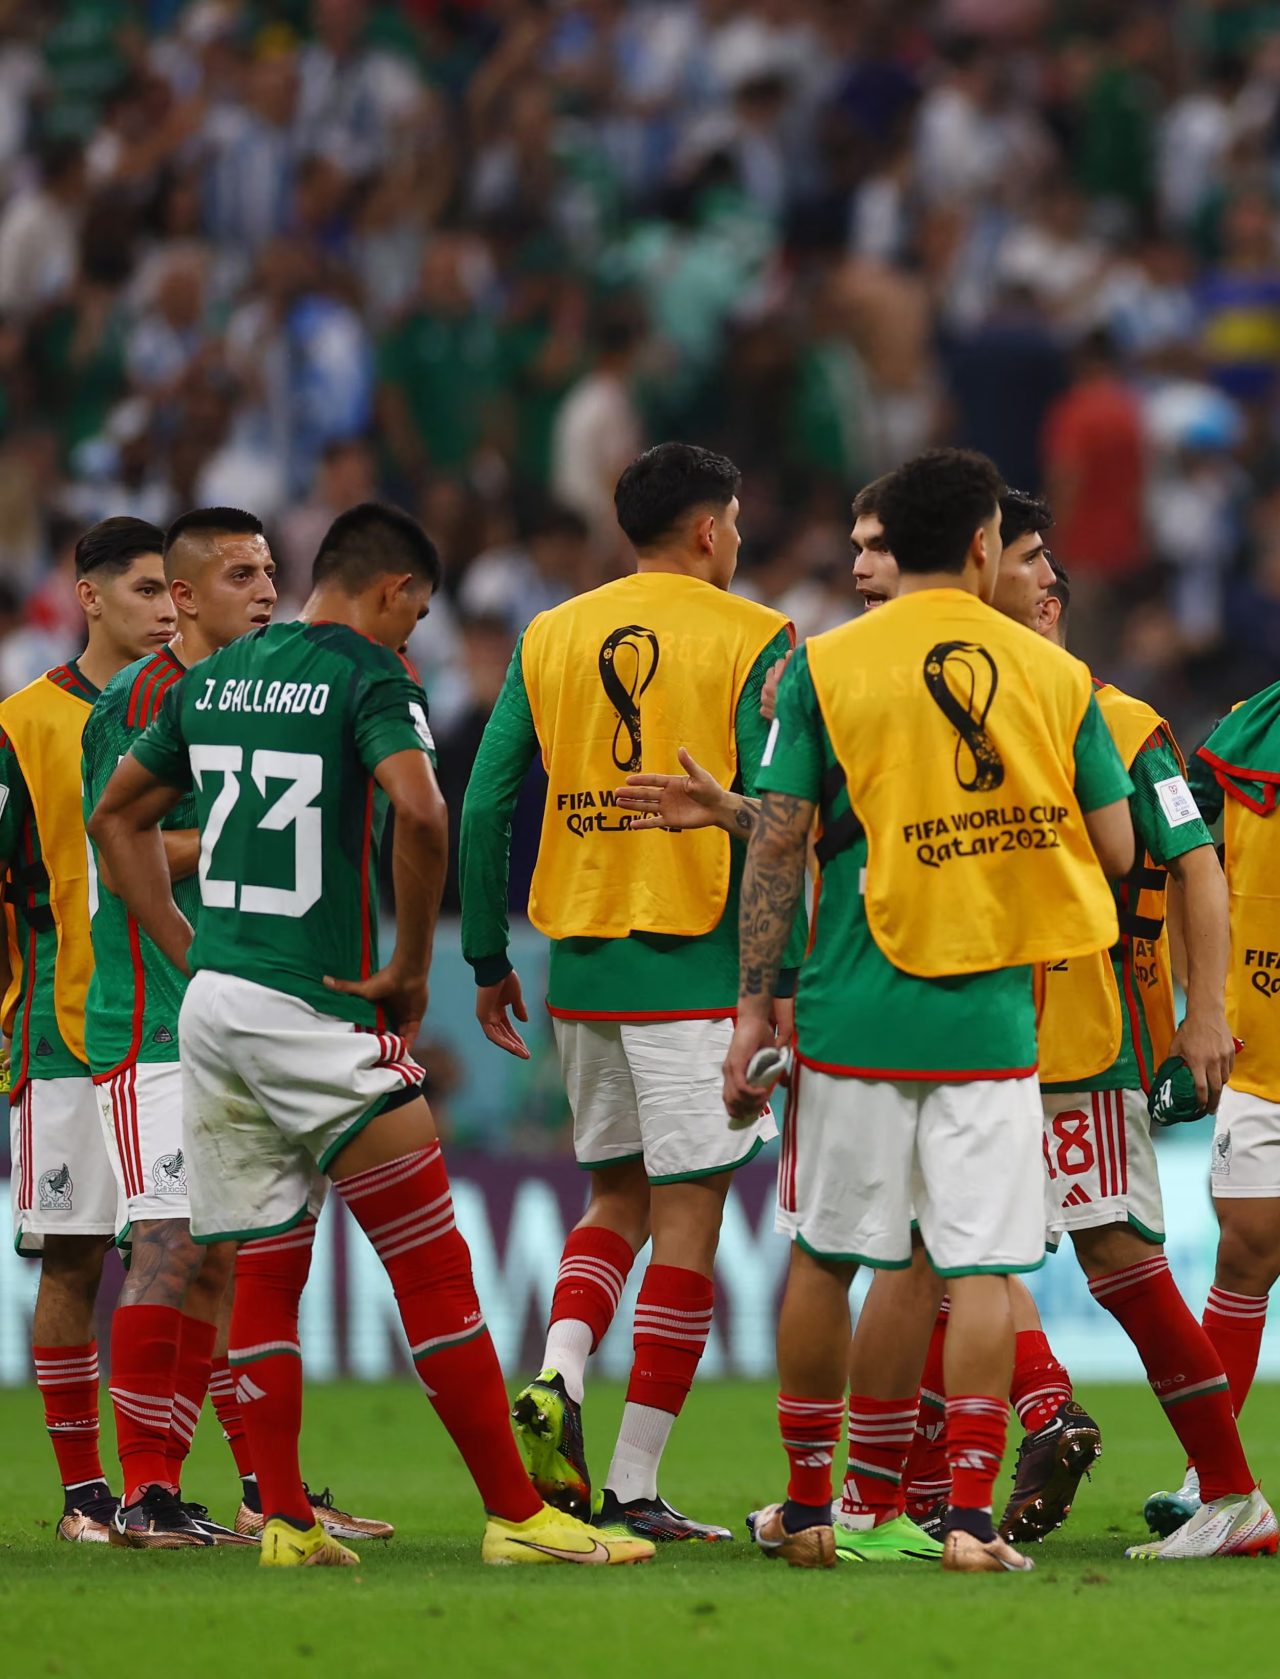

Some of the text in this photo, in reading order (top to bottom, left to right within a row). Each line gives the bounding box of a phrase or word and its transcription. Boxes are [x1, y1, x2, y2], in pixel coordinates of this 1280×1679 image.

[195, 678, 330, 715] J. GALLARDO
[558, 791, 596, 811] FIFA
[189, 744, 323, 918] 23
[903, 806, 1068, 843] FIFA WORLD CUP
